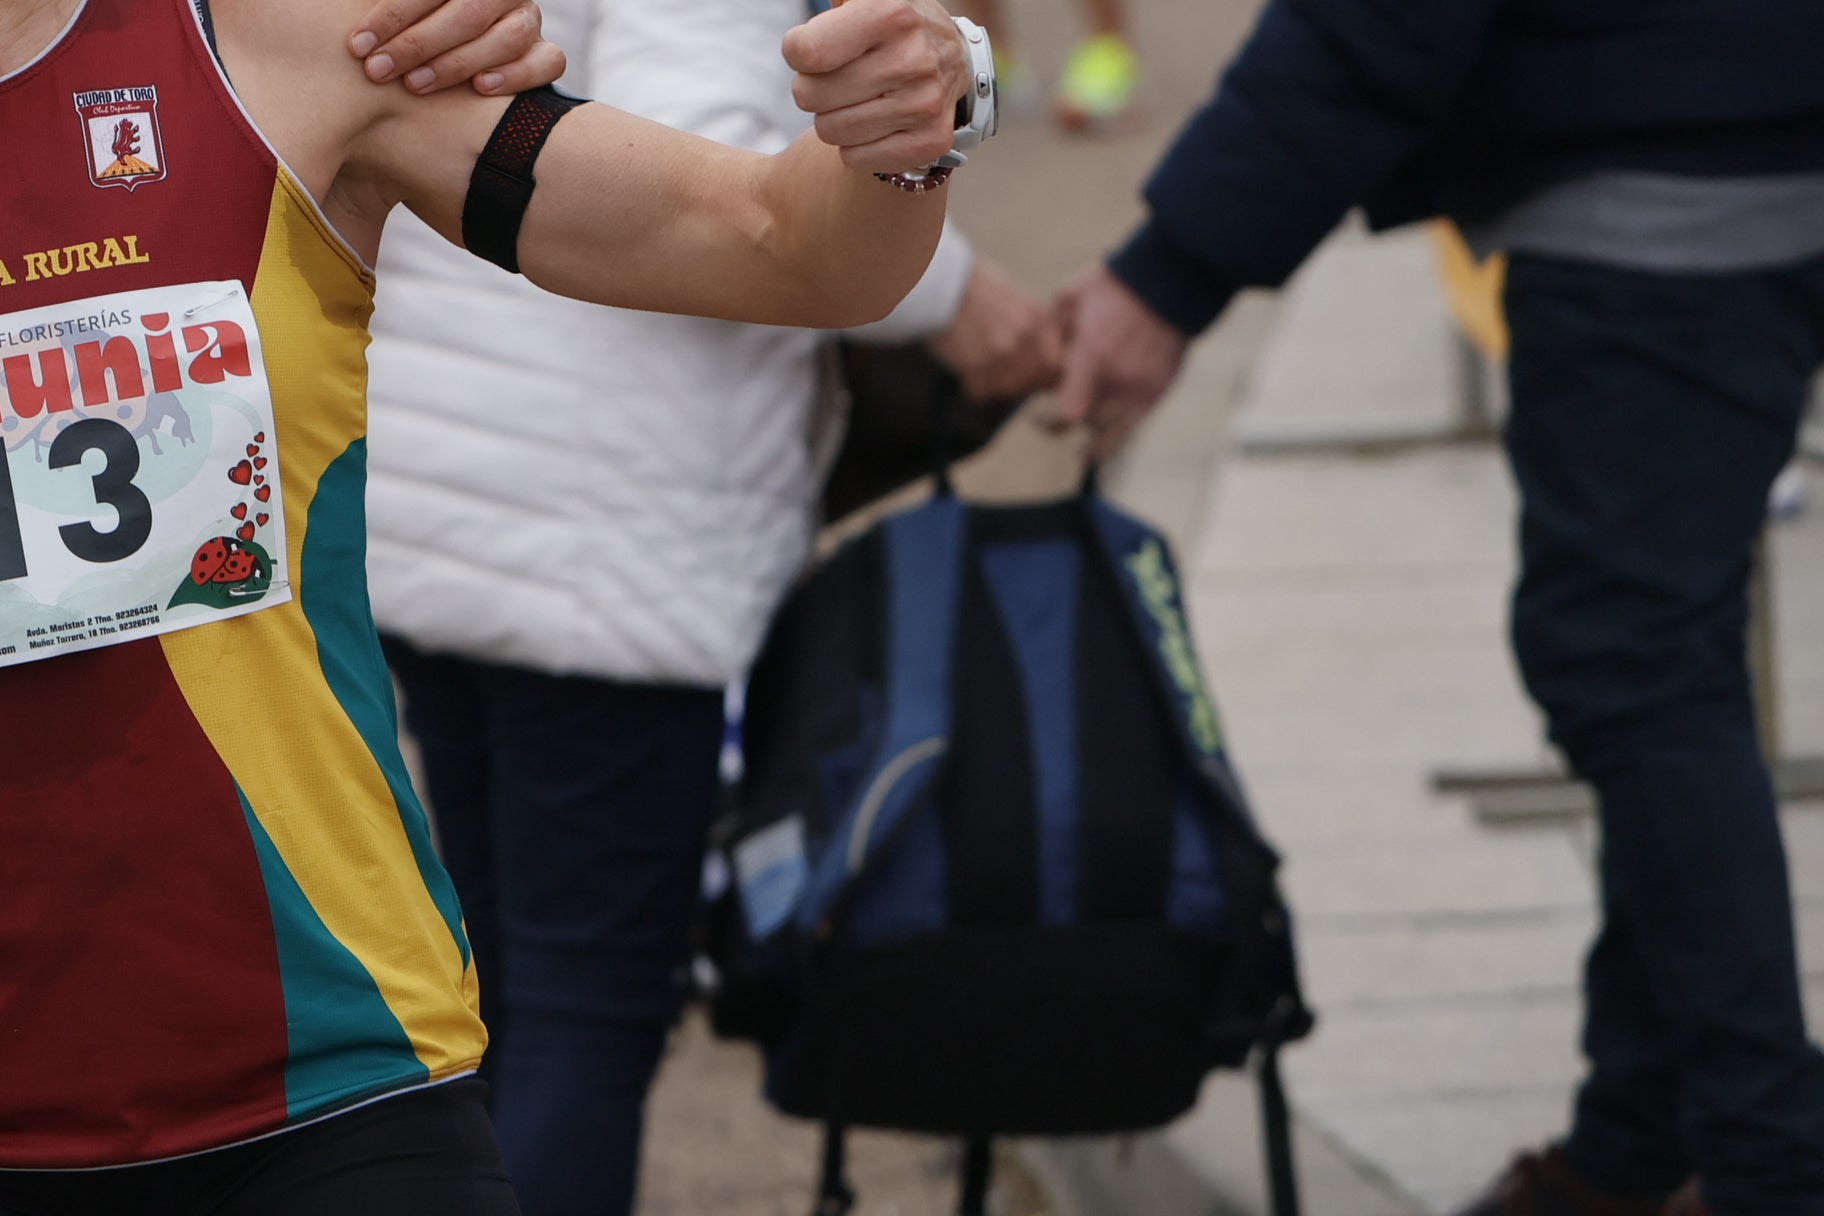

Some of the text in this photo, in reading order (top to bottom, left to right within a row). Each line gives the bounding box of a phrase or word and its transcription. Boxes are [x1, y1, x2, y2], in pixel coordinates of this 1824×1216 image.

[76, 88, 154, 106] CIUDAD DE TORO
[23, 235, 150, 282] RURAL
[50, 621, 86, 634] Maristas
[87, 618, 93, 626] 2
